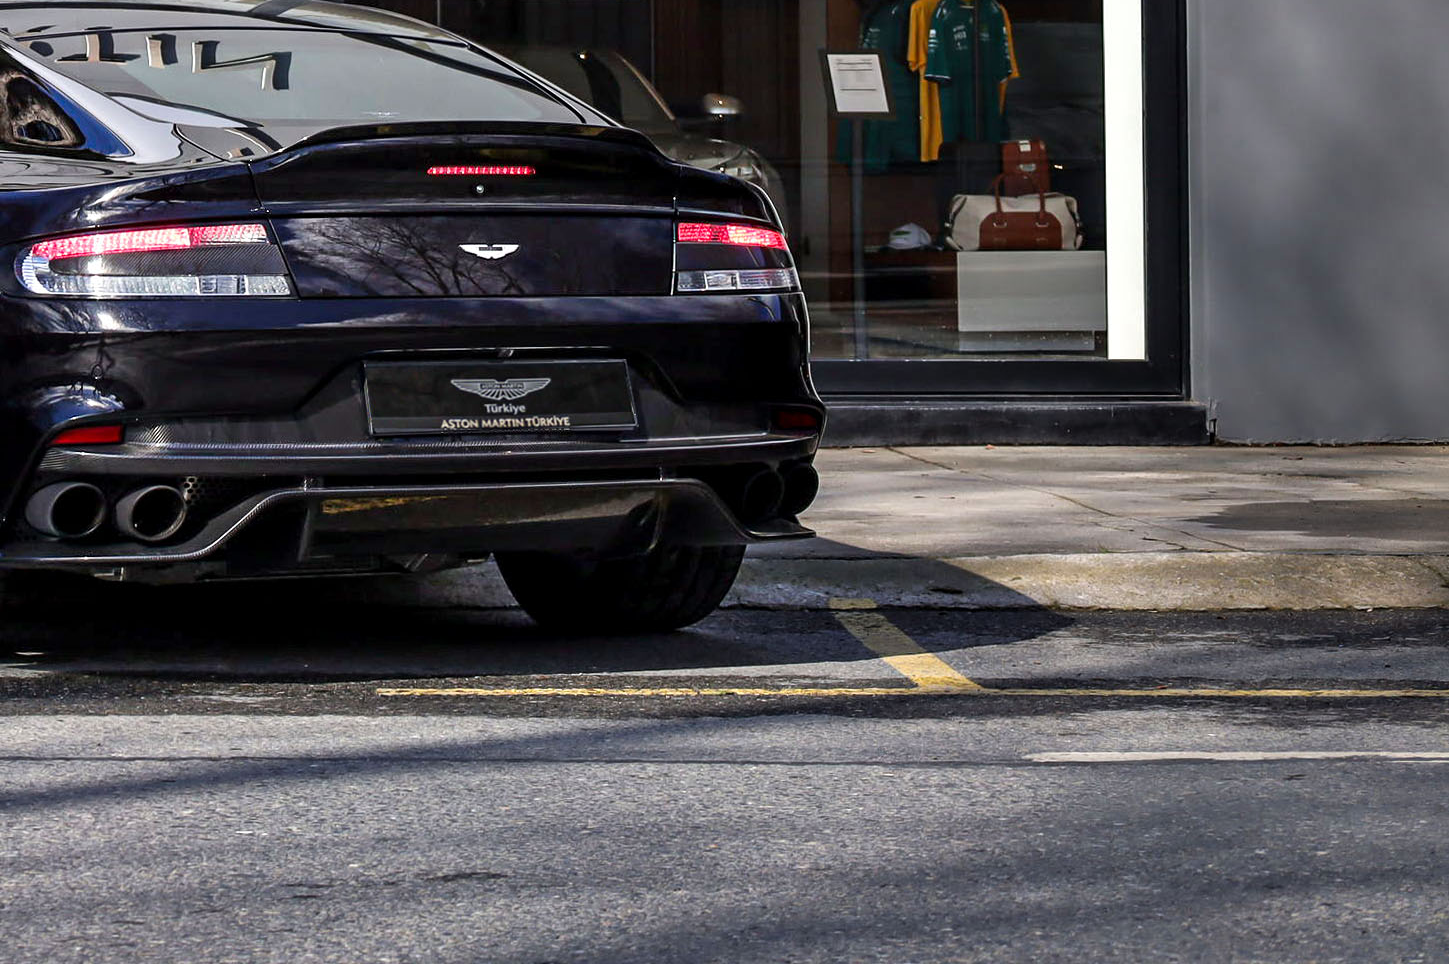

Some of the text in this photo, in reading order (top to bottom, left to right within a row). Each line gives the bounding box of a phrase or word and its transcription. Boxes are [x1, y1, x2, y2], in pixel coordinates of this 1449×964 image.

[484, 404, 525, 415] Türkiye
[441, 419, 479, 429] ASTON
[482, 417, 524, 428] MARTIN
